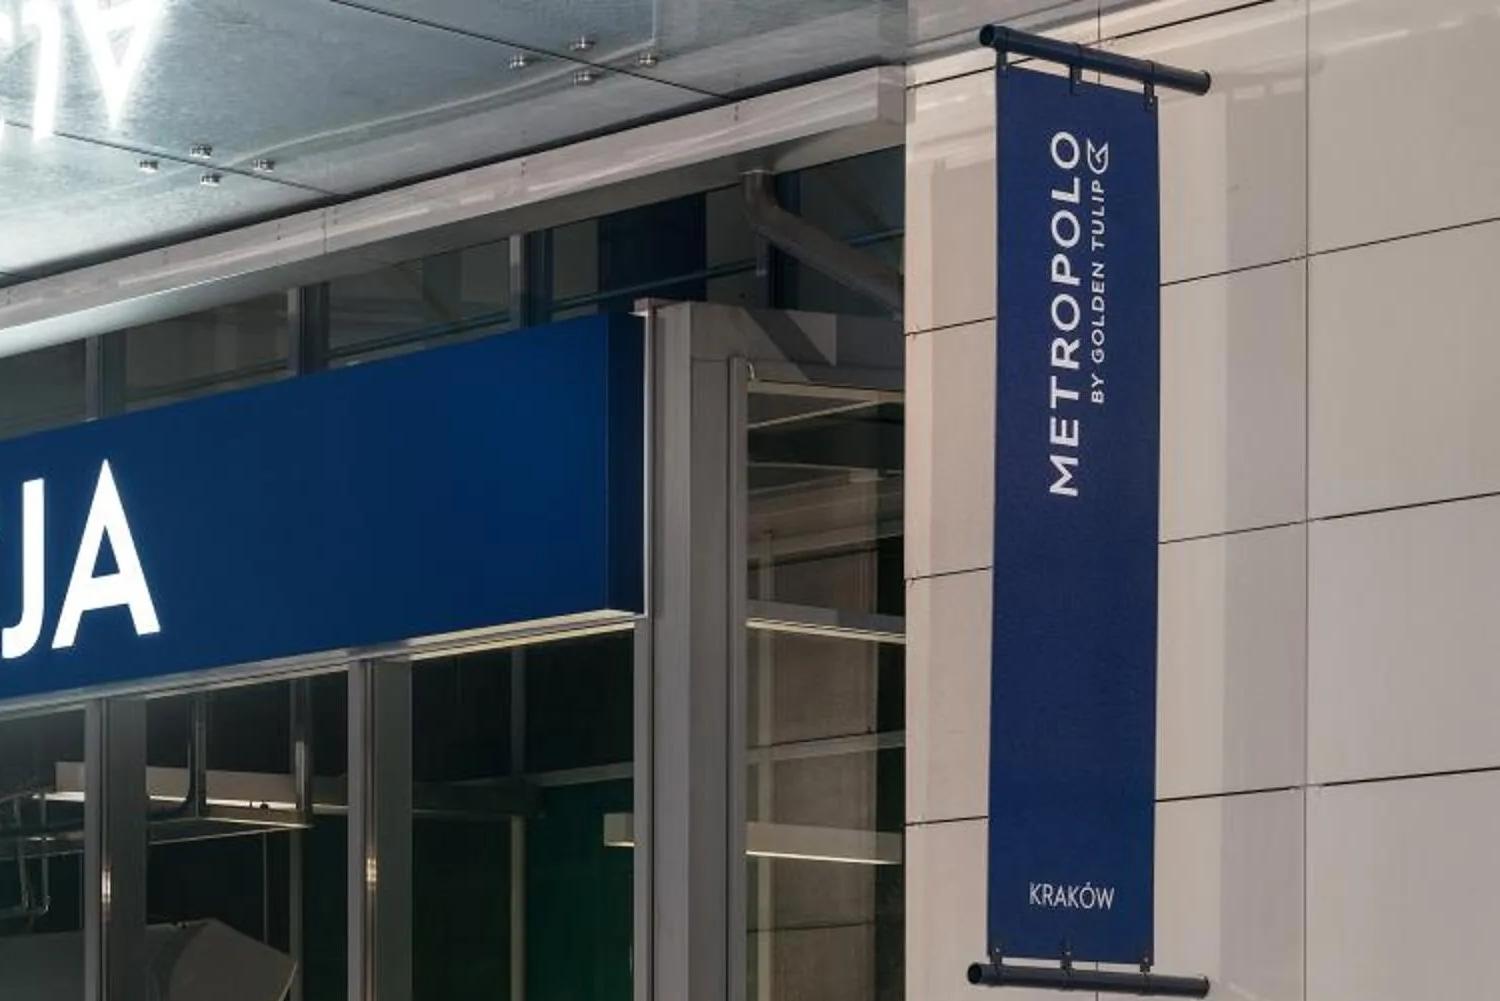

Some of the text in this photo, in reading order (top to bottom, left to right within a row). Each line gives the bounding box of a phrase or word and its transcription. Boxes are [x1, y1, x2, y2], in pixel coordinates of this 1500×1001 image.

[1049, 131, 1081, 497] METROPOLO
[1091, 179, 1105, 404] BY GOLDEN TULIP
[1029, 881, 1115, 910] KRAKÓW
